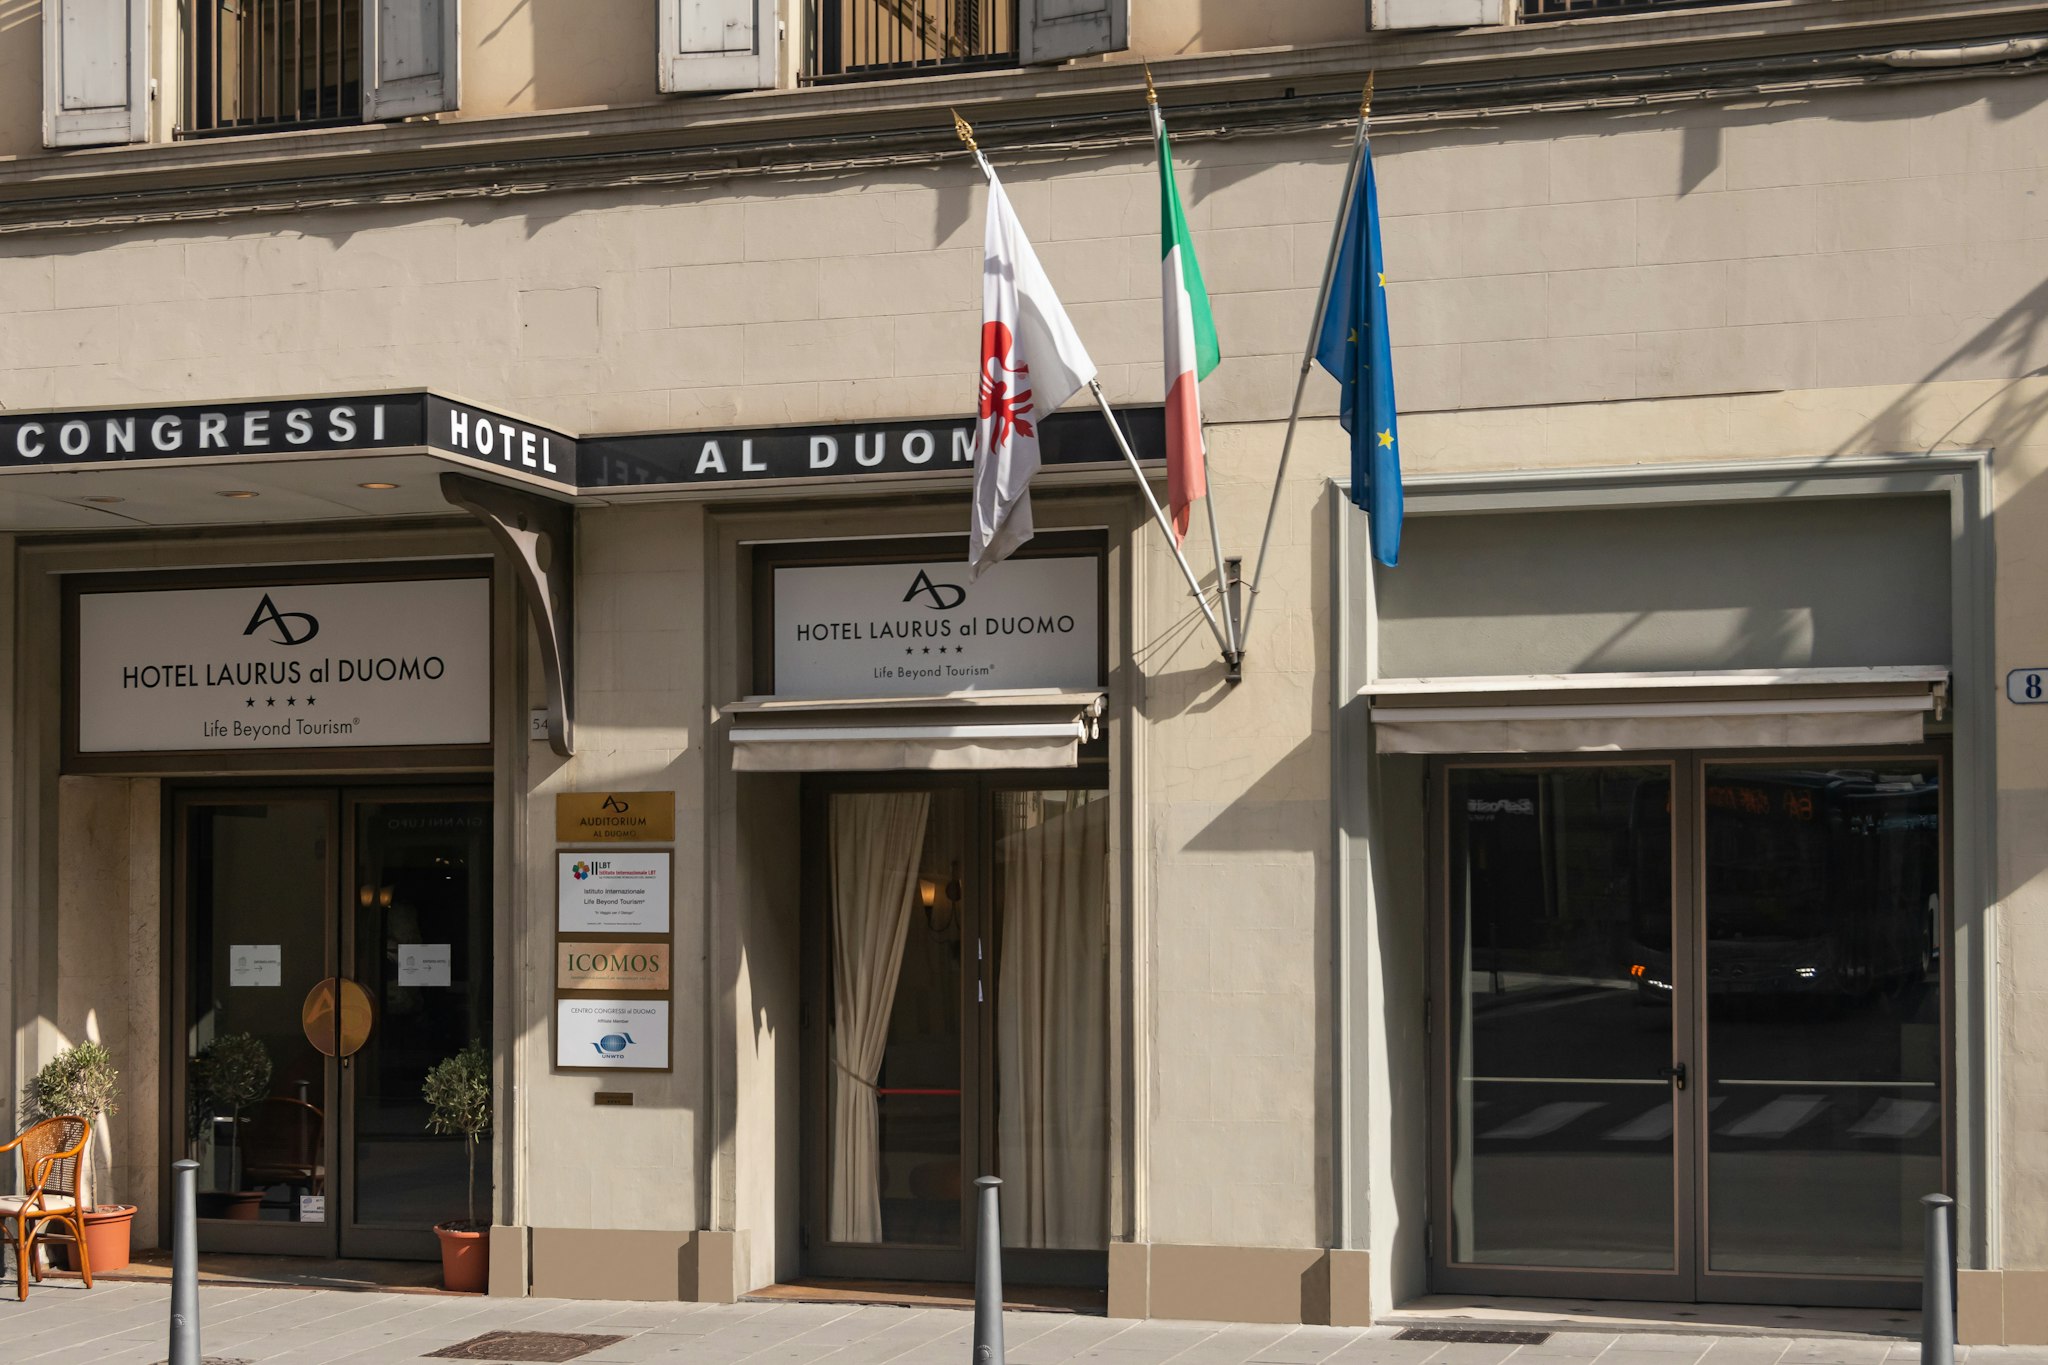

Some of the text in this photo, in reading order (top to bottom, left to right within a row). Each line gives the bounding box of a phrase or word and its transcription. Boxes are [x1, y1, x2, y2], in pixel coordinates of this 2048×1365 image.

[16, 404, 386, 459] CONGRESSI
[451, 409, 557, 474] HOTEL
[695, 429, 978, 474] AL DUOM
[798, 615, 1075, 642] HOTEL LAURUS al DUOMO
[123, 656, 445, 689] HOTEL LAURUS al DUOMO
[874, 667, 893, 679] Life
[898, 665, 942, 681] Beyond
[2025, 673, 2042, 699] 8
[204, 719, 228, 737] Life
[233, 717, 291, 741] Beyond
[580, 817, 647, 826] AUDITORIUM
[568, 953, 660, 972] ICOMOS
